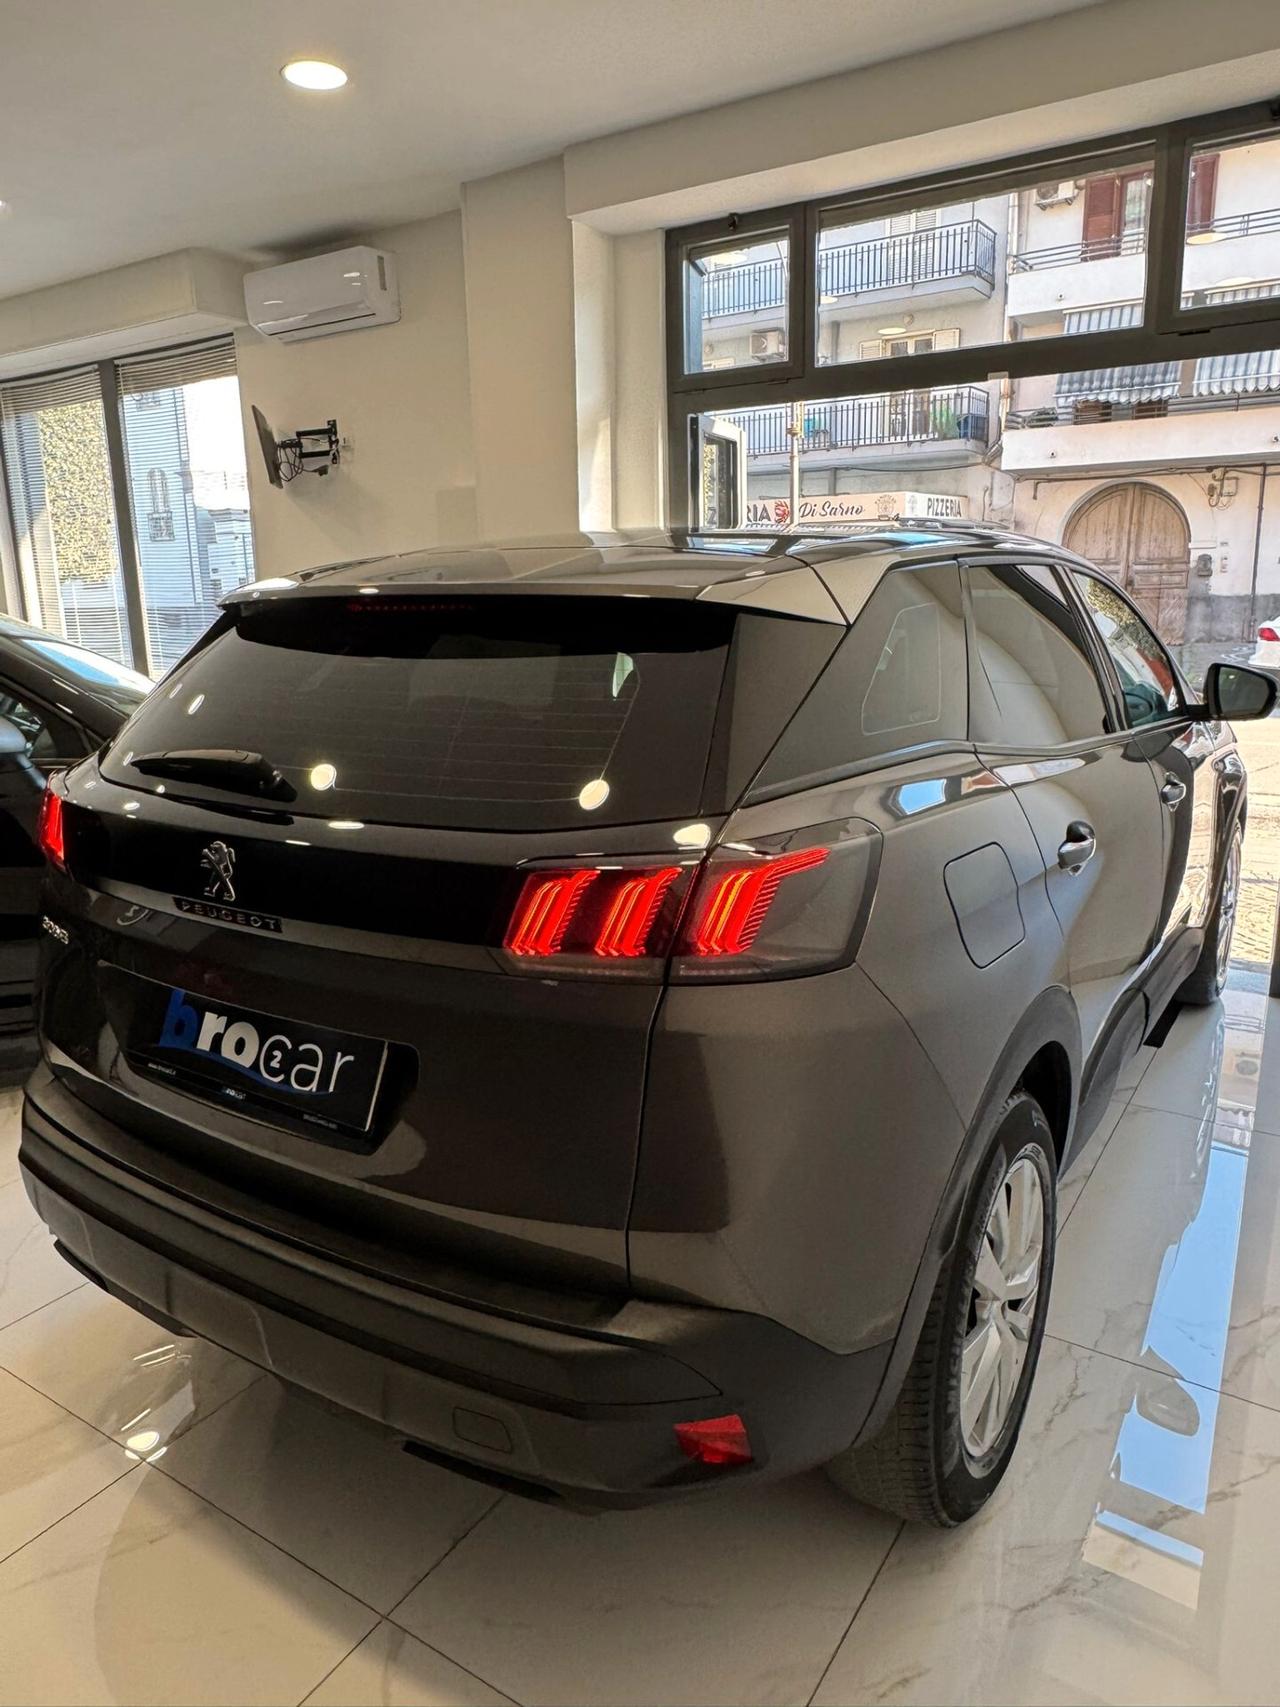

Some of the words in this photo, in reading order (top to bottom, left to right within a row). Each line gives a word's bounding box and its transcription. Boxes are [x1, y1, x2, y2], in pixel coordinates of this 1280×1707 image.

[799, 502, 817, 518] Di
[819, 500, 865, 517] Sarno
[927, 497, 962, 517] PIZZERIA
[181, 901, 277, 930] PEUGEOT
[159, 988, 354, 1093] brocar
